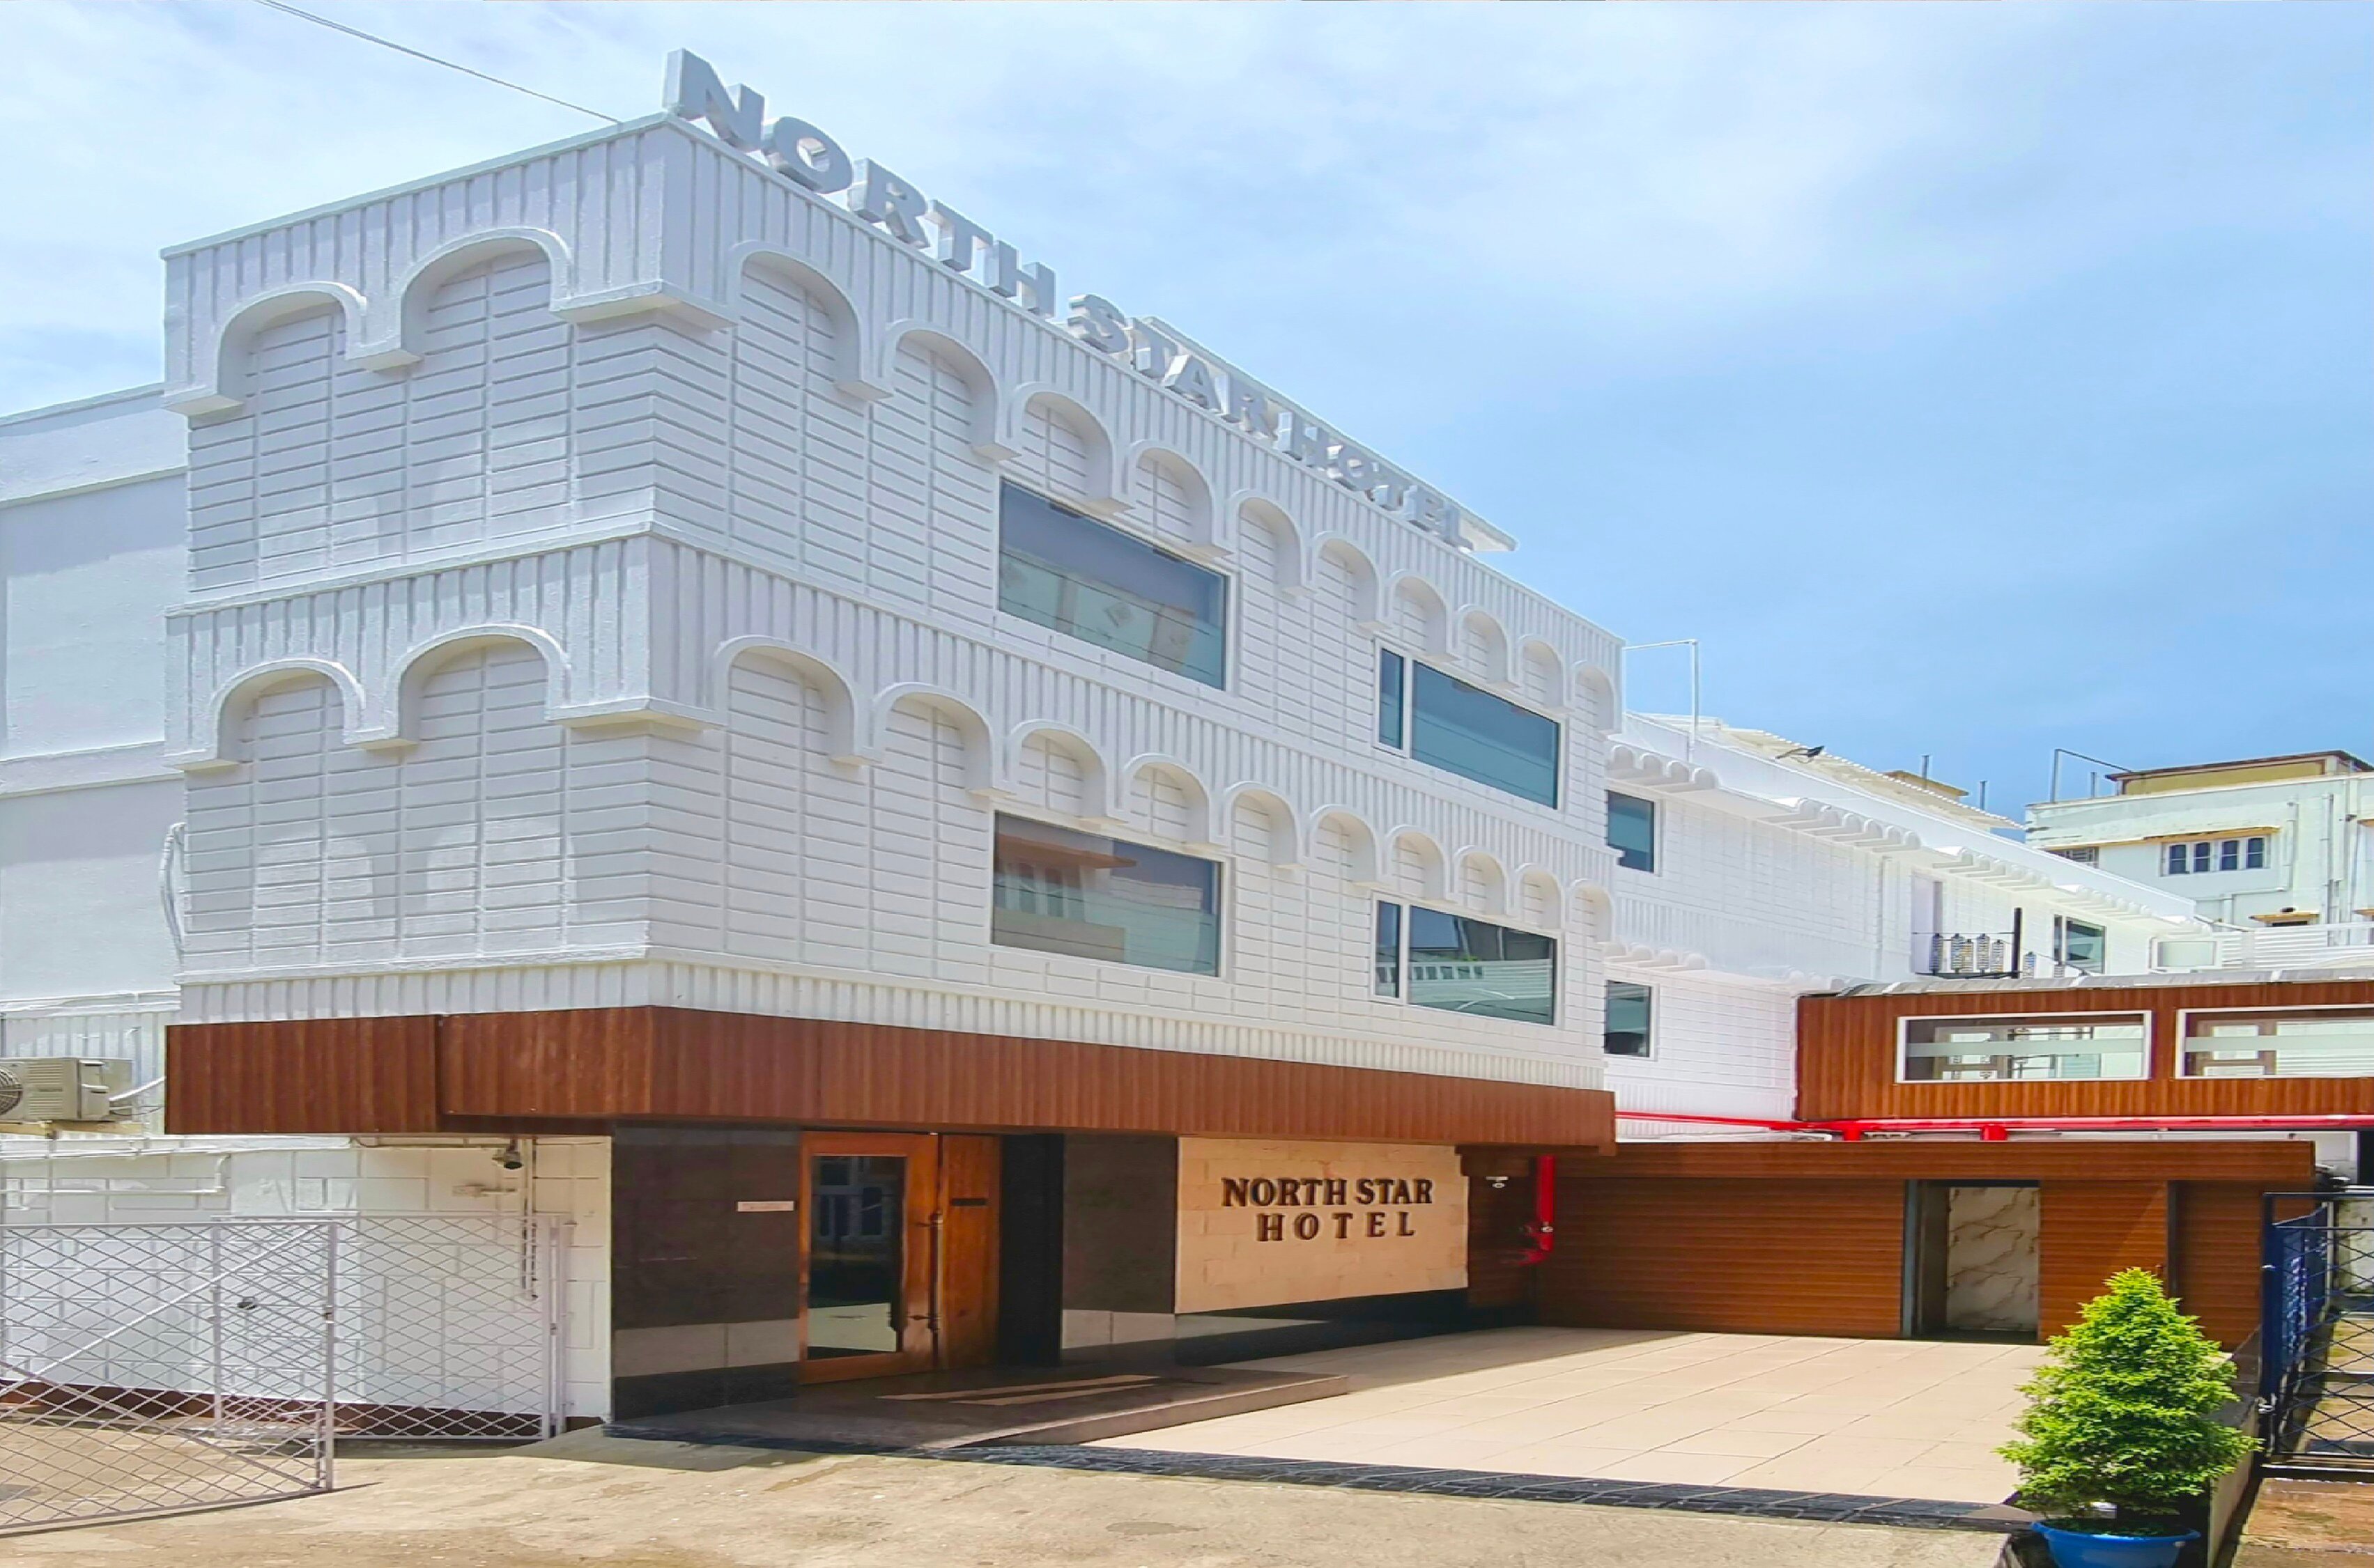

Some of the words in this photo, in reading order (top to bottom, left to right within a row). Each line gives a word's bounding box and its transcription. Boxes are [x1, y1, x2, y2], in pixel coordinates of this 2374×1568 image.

[662, 47, 1056, 318] NORTH
[1067, 293, 1273, 438] STAR
[1277, 411, 1474, 552] HOTEL
[1221, 1177, 1347, 1207] NORTH
[1355, 1178, 1433, 1205] STAR
[1257, 1211, 1415, 1242] HOTEL
